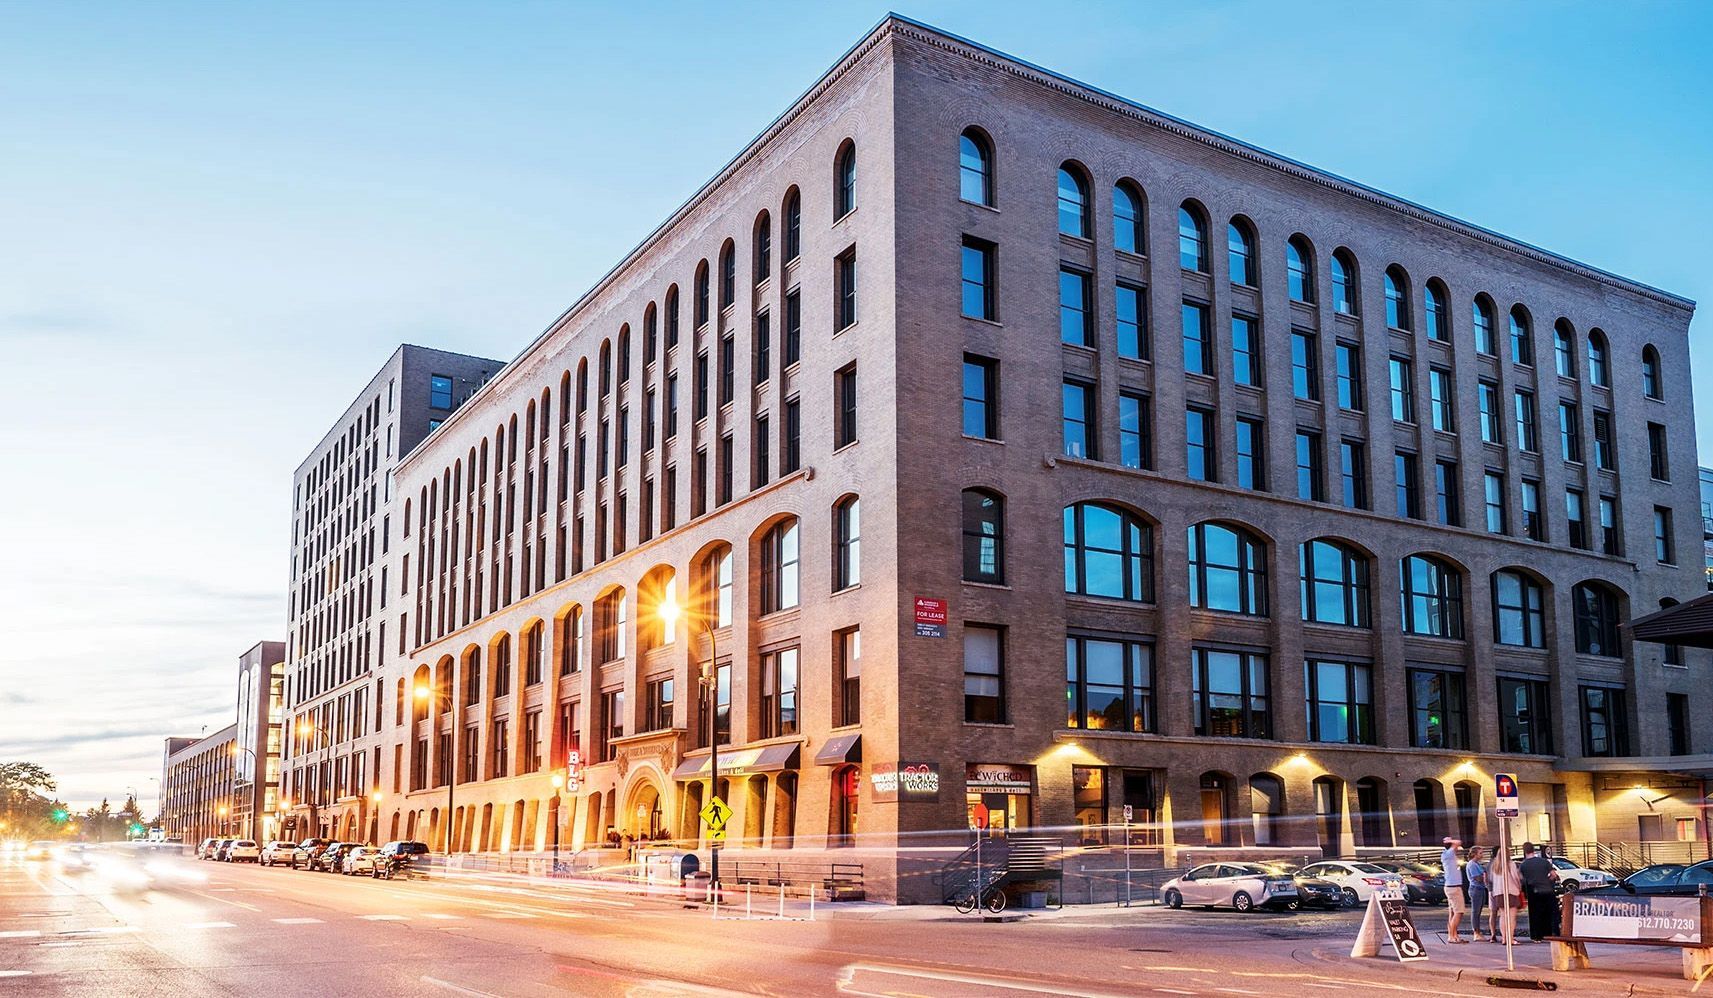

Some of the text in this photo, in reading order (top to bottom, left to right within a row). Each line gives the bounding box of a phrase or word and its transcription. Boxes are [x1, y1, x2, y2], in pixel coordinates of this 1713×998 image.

[568, 751, 580, 792] BLG
[898, 771, 939, 782] TRACTOR
[907, 780, 939, 791] WORKS
[1638, 917, 1695, 930] 612.770.7230
